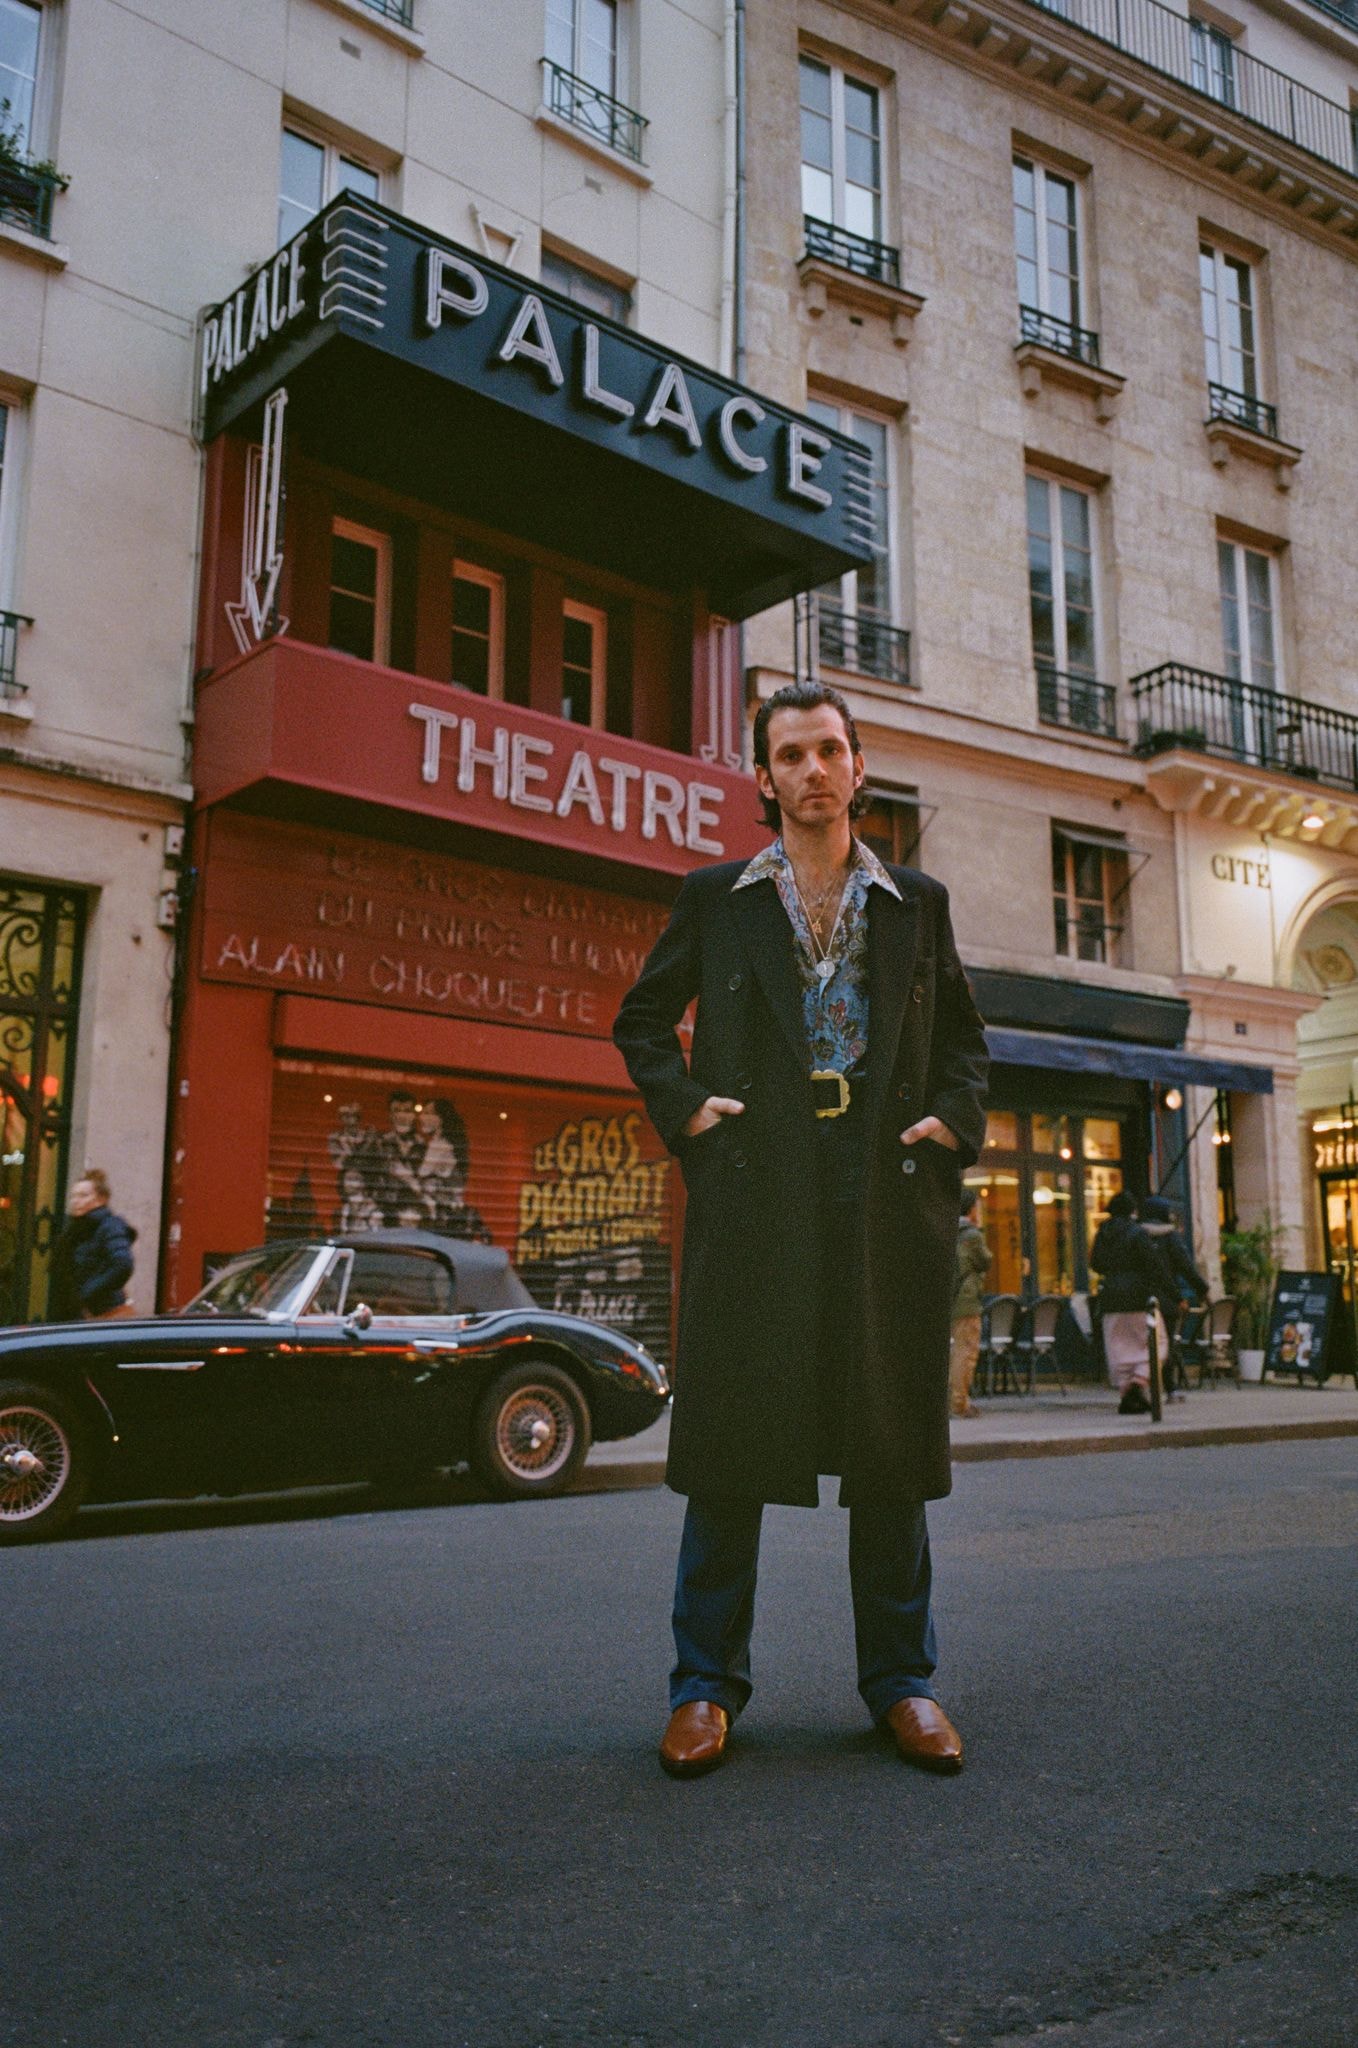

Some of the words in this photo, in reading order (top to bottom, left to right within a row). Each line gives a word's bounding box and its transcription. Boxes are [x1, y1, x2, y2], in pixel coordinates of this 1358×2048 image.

[200, 231, 309, 396] PALACE
[425, 246, 833, 508] PALACE
[408, 702, 725, 857] THEATRE
[218, 933, 345, 983] ALAIN
[556, 1110, 640, 1179] GROS
